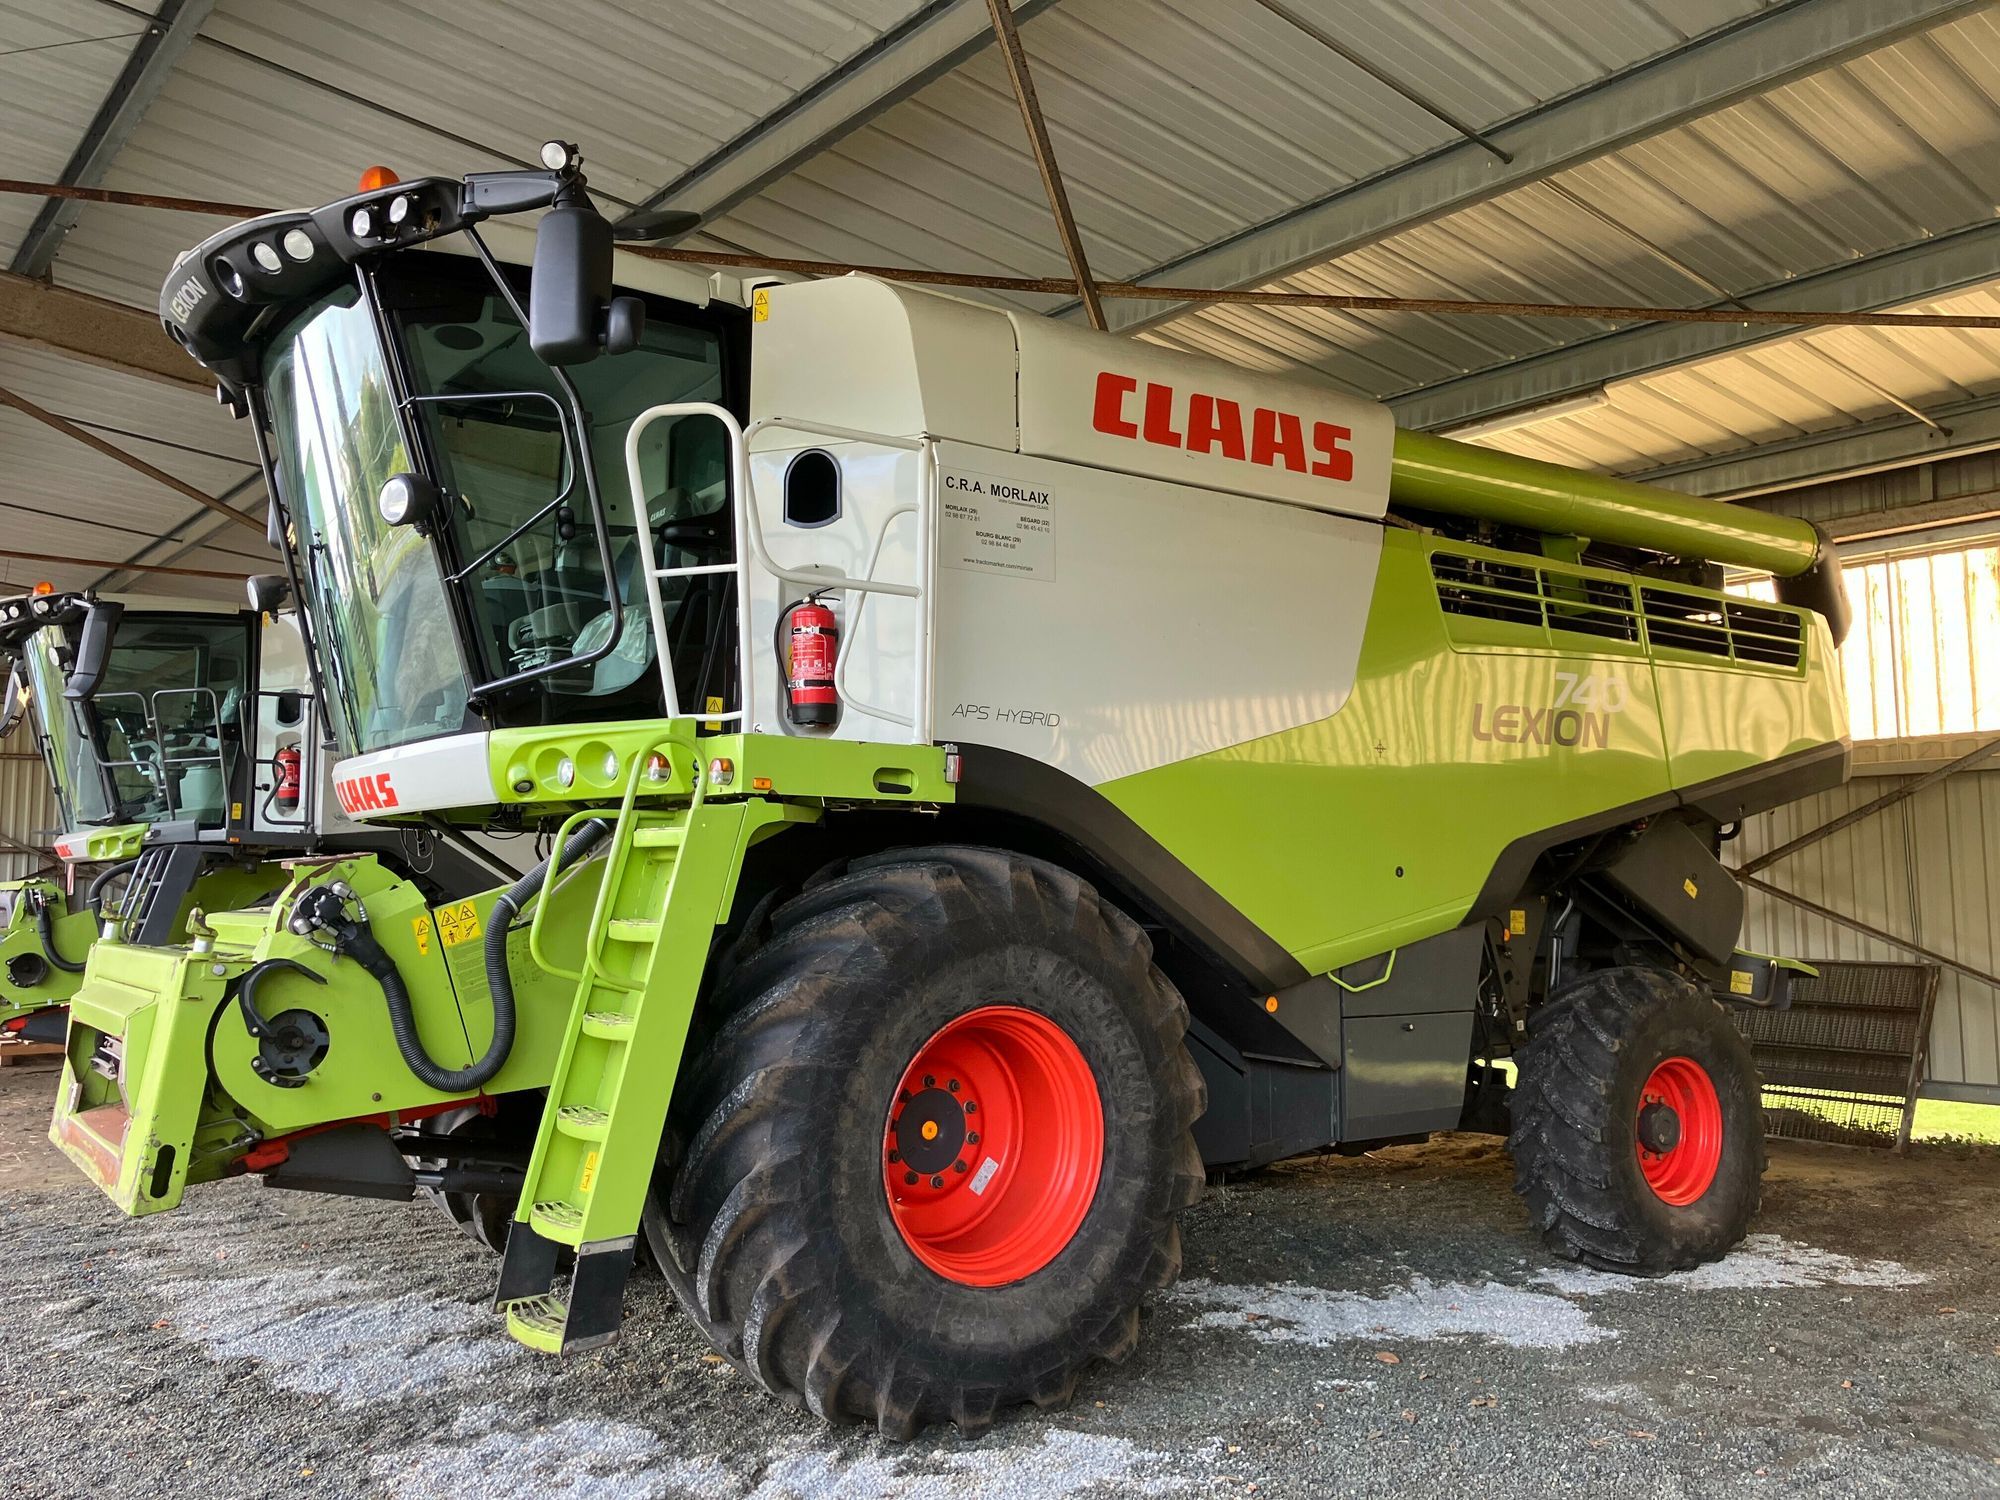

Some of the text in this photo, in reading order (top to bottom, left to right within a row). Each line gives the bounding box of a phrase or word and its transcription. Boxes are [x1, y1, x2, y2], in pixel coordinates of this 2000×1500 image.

[170, 275, 207, 324] LEXION
[1093, 371, 1353, 482] CLAAS
[945, 476, 986, 495] C.R.A.
[990, 484, 1049, 506] MORLAIX
[945, 503, 968, 513] MORLAIX
[1553, 671, 1628, 713] 740
[951, 703, 1061, 727] APS HYBRID
[1472, 703, 1611, 749] LEXION
